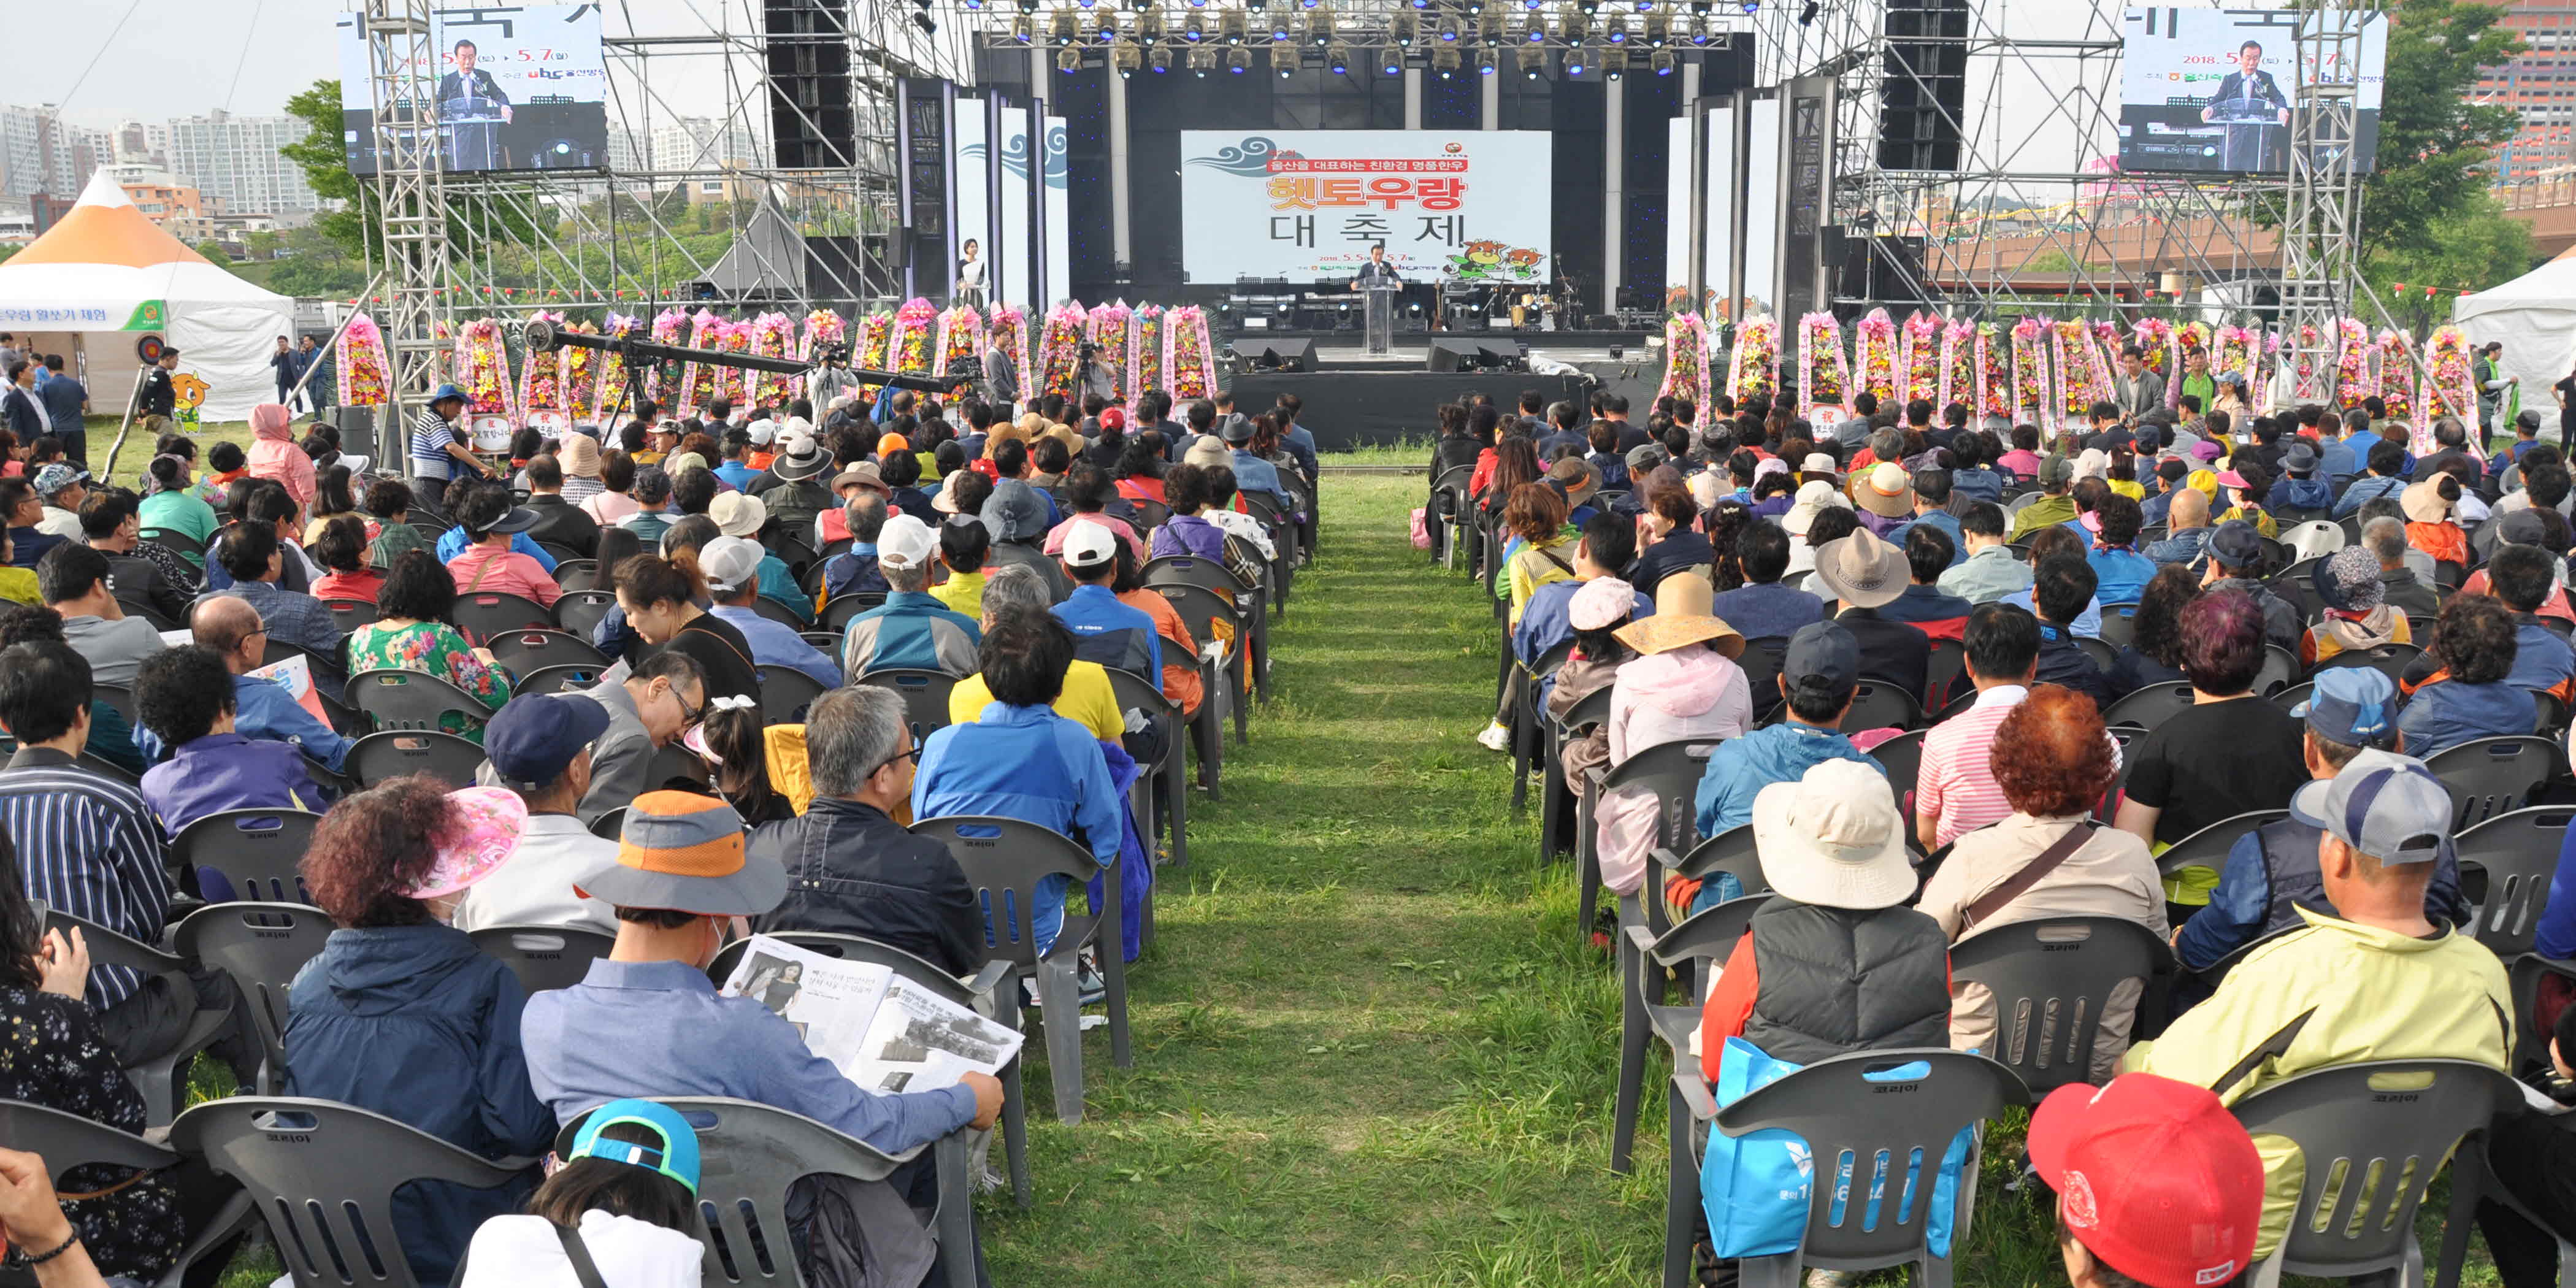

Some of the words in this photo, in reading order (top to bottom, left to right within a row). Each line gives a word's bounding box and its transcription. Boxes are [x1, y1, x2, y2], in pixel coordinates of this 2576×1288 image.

[1271, 161, 1309, 171] 울산을
[1314, 161, 1366, 171] 대표하는
[1370, 161, 1408, 171] 친환경
[1412, 161, 1464, 171] 명품한우
[1267, 176, 1468, 212] 햇토우랑
[1873, 1083, 1919, 1094] 코리아
